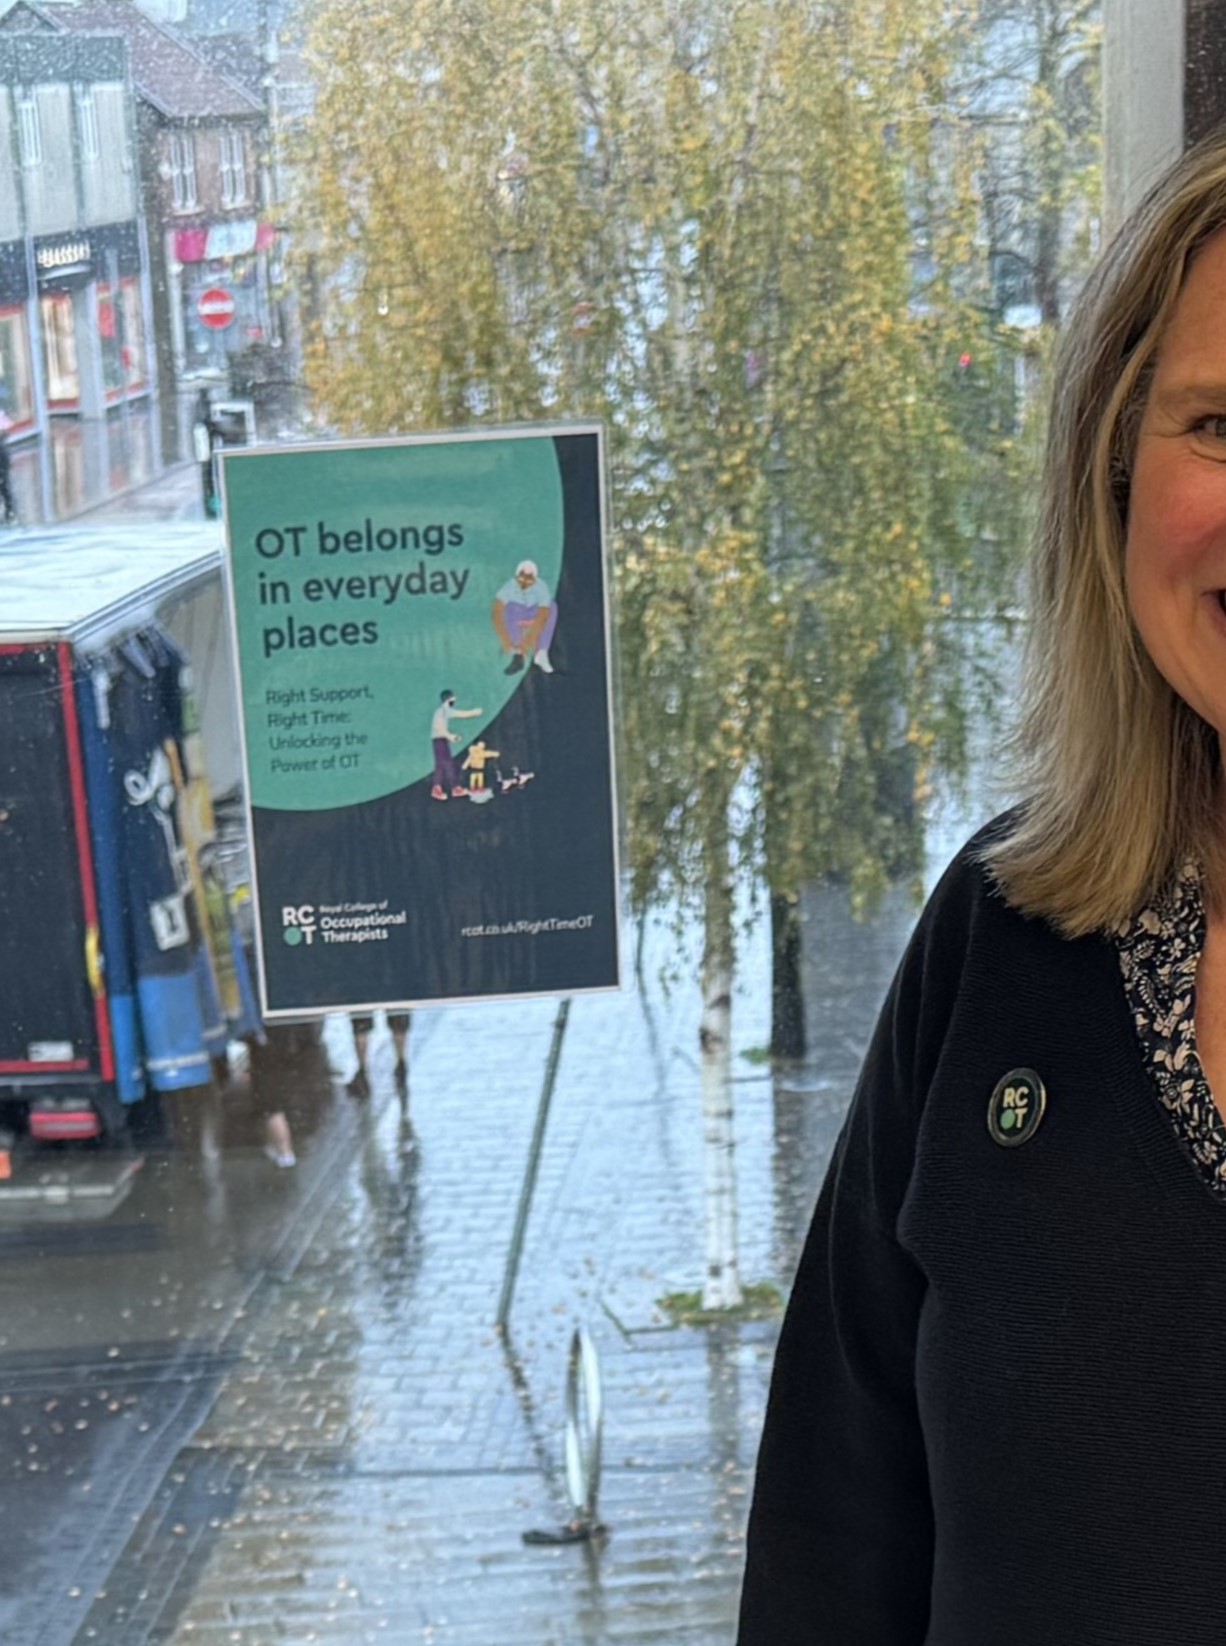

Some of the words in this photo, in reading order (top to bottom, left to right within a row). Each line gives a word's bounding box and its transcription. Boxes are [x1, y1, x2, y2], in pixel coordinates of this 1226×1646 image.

[256, 526, 307, 559] OT
[318, 518, 464, 555] belongs
[258, 571, 290, 605] in
[303, 561, 470, 605] everyday
[263, 615, 378, 658] places
[266, 689, 306, 707] Right
[309, 686, 374, 703] Support,
[267, 711, 308, 730] Right
[269, 733, 341, 751] Unlocking
[345, 732, 368, 746] the
[271, 759, 318, 773] Power
[322, 755, 335, 770] of
[340, 754, 360, 769] OT
[344, 902, 377, 912] College
[321, 910, 406, 929] Occupational
[322, 928, 388, 943] Therapists
